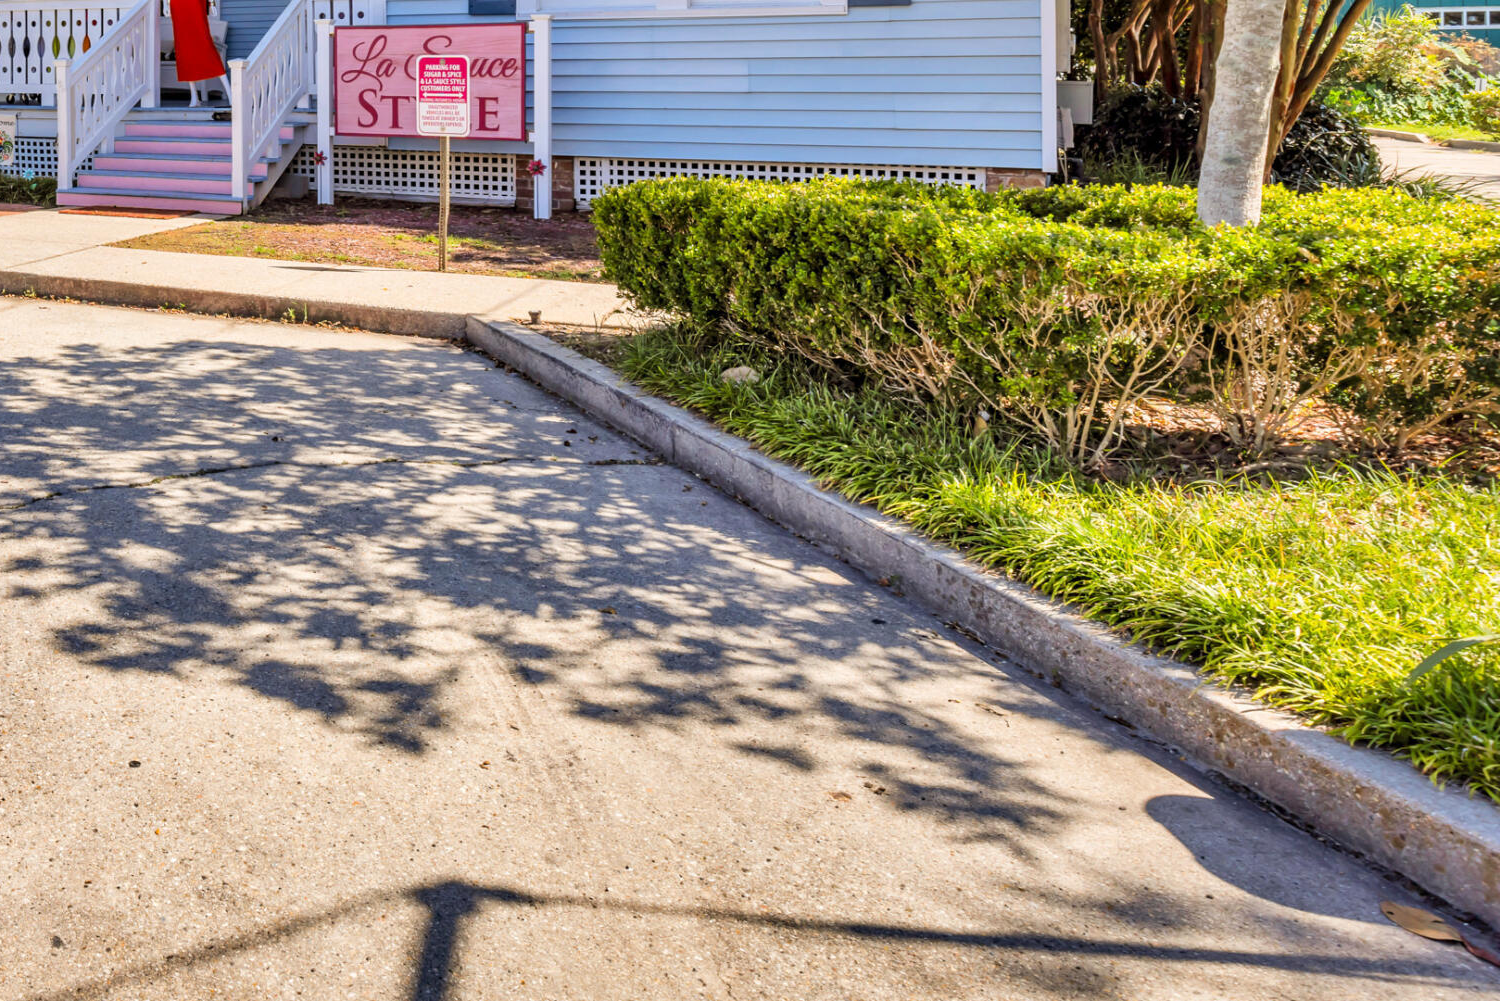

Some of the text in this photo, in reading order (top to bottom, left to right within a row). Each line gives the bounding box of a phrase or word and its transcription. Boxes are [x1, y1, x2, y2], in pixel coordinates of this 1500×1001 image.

[341, 34, 518, 92] La Suce
[357, 88, 500, 132] STE
